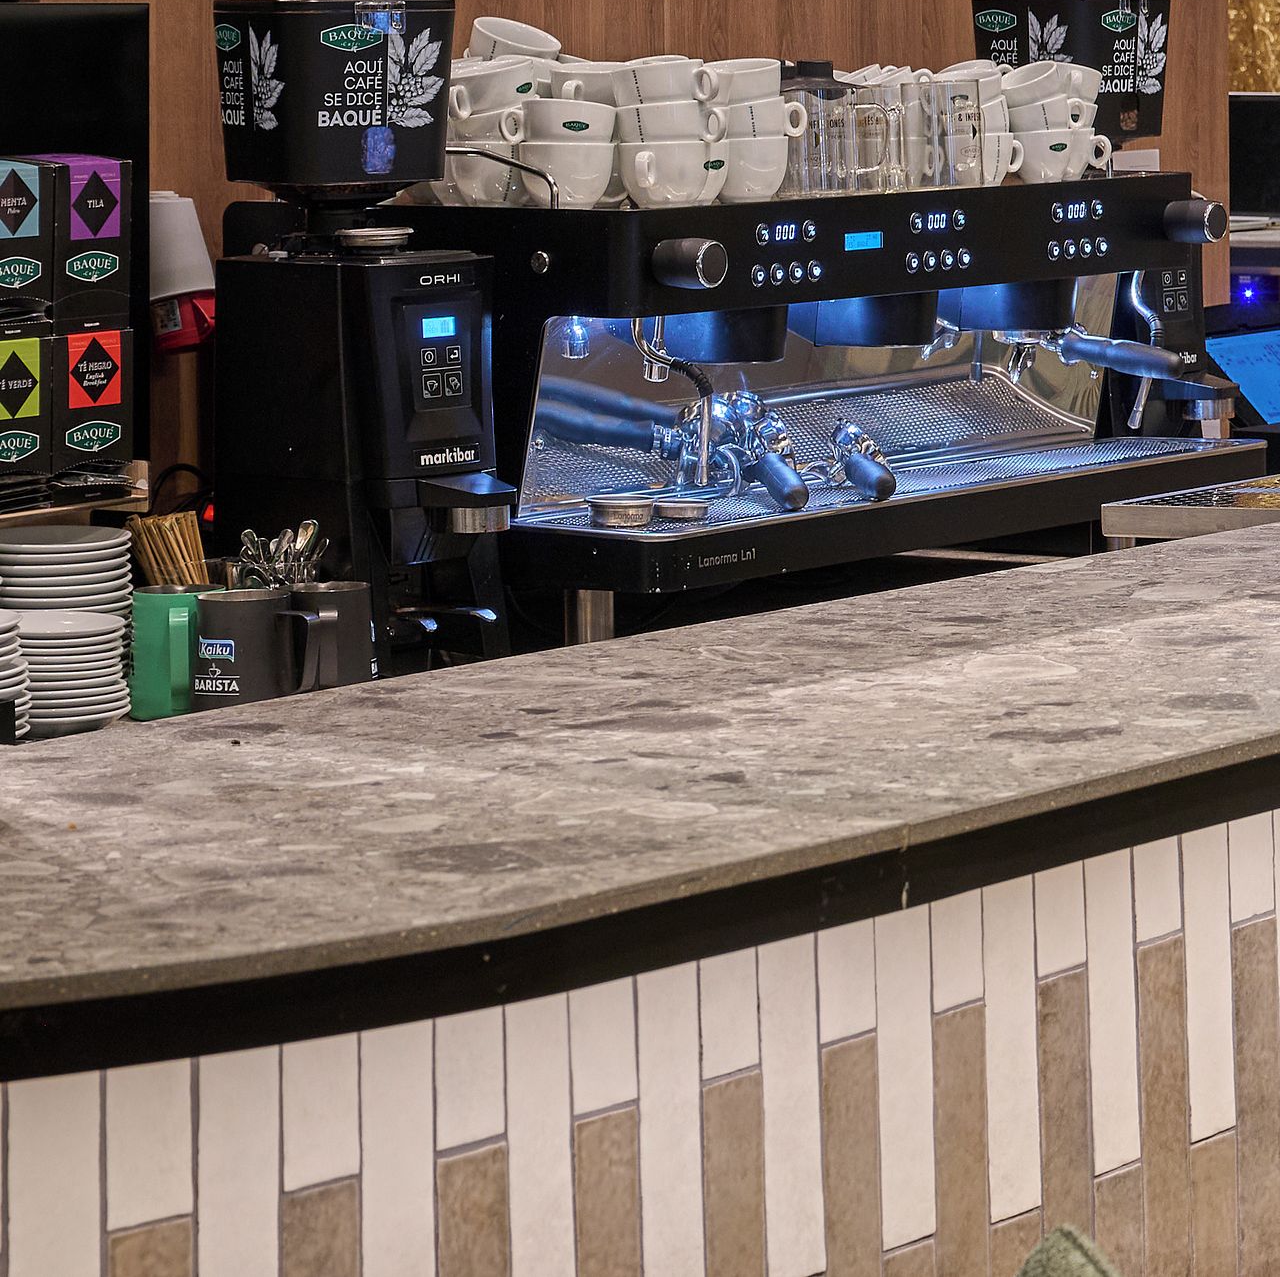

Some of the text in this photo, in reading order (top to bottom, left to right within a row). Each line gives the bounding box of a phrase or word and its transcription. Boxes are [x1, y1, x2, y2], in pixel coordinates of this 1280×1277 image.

[329, 28, 375, 42] BAQUÉ
[990, 37, 1018, 50] AQUÍ
[1113, 37, 1136, 51] AQUÍ
[991, 51, 1018, 64] CAFÉ
[1113, 50, 1135, 63] CAFÉ
[223, 58, 243, 74] AQUÍ
[344, 57, 383, 74] AQUÍ
[1102, 64, 1135, 76] SE DICE
[224, 75, 244, 90] CAFÉ
[344, 75, 383, 90] CAFÉ
[1099, 76, 1134, 93] BAQUÉ
[226, 92, 245, 106] DICE
[324, 92, 383, 106] SE DICE
[221, 108, 246, 126] AQUÉ
[318, 107, 382, 127] BAQUÉ
[87, 199, 104, 209] TILA
[73, 257, 113, 272] BAQUÉ
[419, 273, 461, 286] ORHI
[78, 360, 112, 372] TÉ NEGRO
[83, 378, 108, 388] Breakfast
[85, 372, 105, 380] English
[8, 378, 33, 390] VERDE
[73, 426, 114, 443] BAQUÉ
[0, 436, 33, 450] AQUÉ
[420, 447, 475, 466] markibar
[698, 548, 756, 569] Lanorma Ln1
[200, 642, 231, 656] Kaiku
[194, 678, 240, 692] BARISTA
